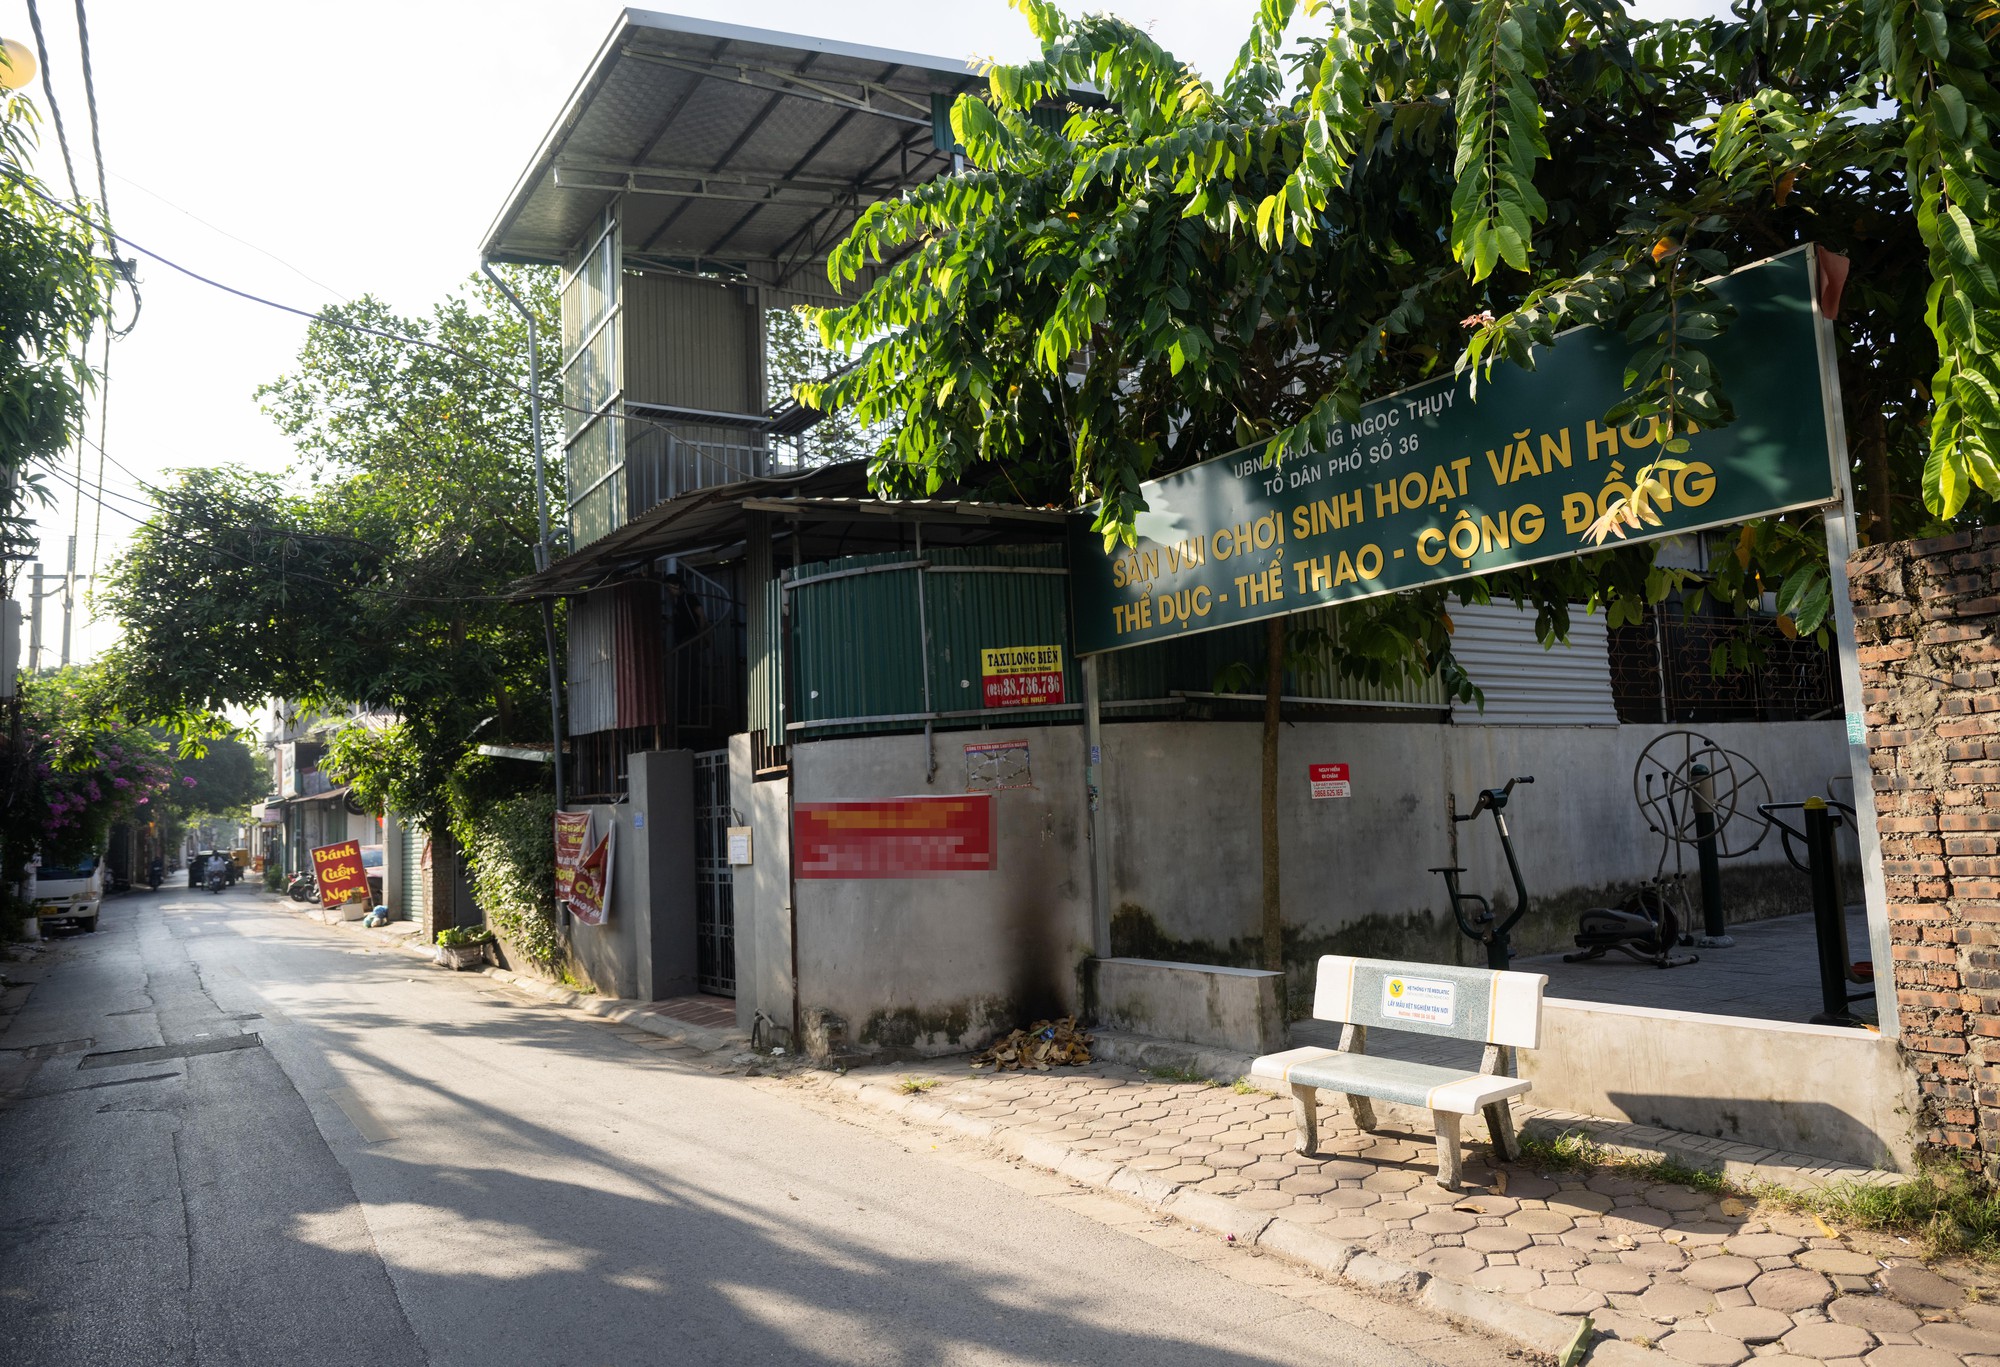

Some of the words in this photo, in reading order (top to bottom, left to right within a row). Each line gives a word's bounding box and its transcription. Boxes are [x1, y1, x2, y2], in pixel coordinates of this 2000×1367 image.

[1350, 409, 1400, 436] NGỌC
[1406, 388, 1456, 420] THỤY
[1263, 467, 1284, 497] TỔ
[1290, 465, 1322, 489] DÂN
[1329, 442, 1363, 477] PHỐ
[1369, 433, 1393, 464] SỐ
[1399, 433, 1419, 455] 36
[1113, 547, 1159, 589] SÂN
[1165, 535, 1206, 574] VUI
[1211, 508, 1286, 561] CHƠI
[1292, 488, 1364, 540] SINH
[1374, 456, 1472, 519] HOẠT
[1485, 428, 1573, 486] VĂN
[1112, 581, 1152, 635] THỂ
[1159, 585, 1212, 630] DỤC
[1234, 547, 1284, 609] THỂ
[1293, 543, 1384, 596] THAO
[1416, 503, 1546, 569] CỘNG
[987, 653, 1010, 667] TAXI
[1012, 651, 1036, 666] LONG
[1038, 647, 1058, 665] BIÊN
[314, 845, 358, 863] Bánh
[321, 863, 359, 883] Cuốn
[323, 886, 367, 902] Ngn
[1414, 1003, 1432, 1012] NGHIỆM
